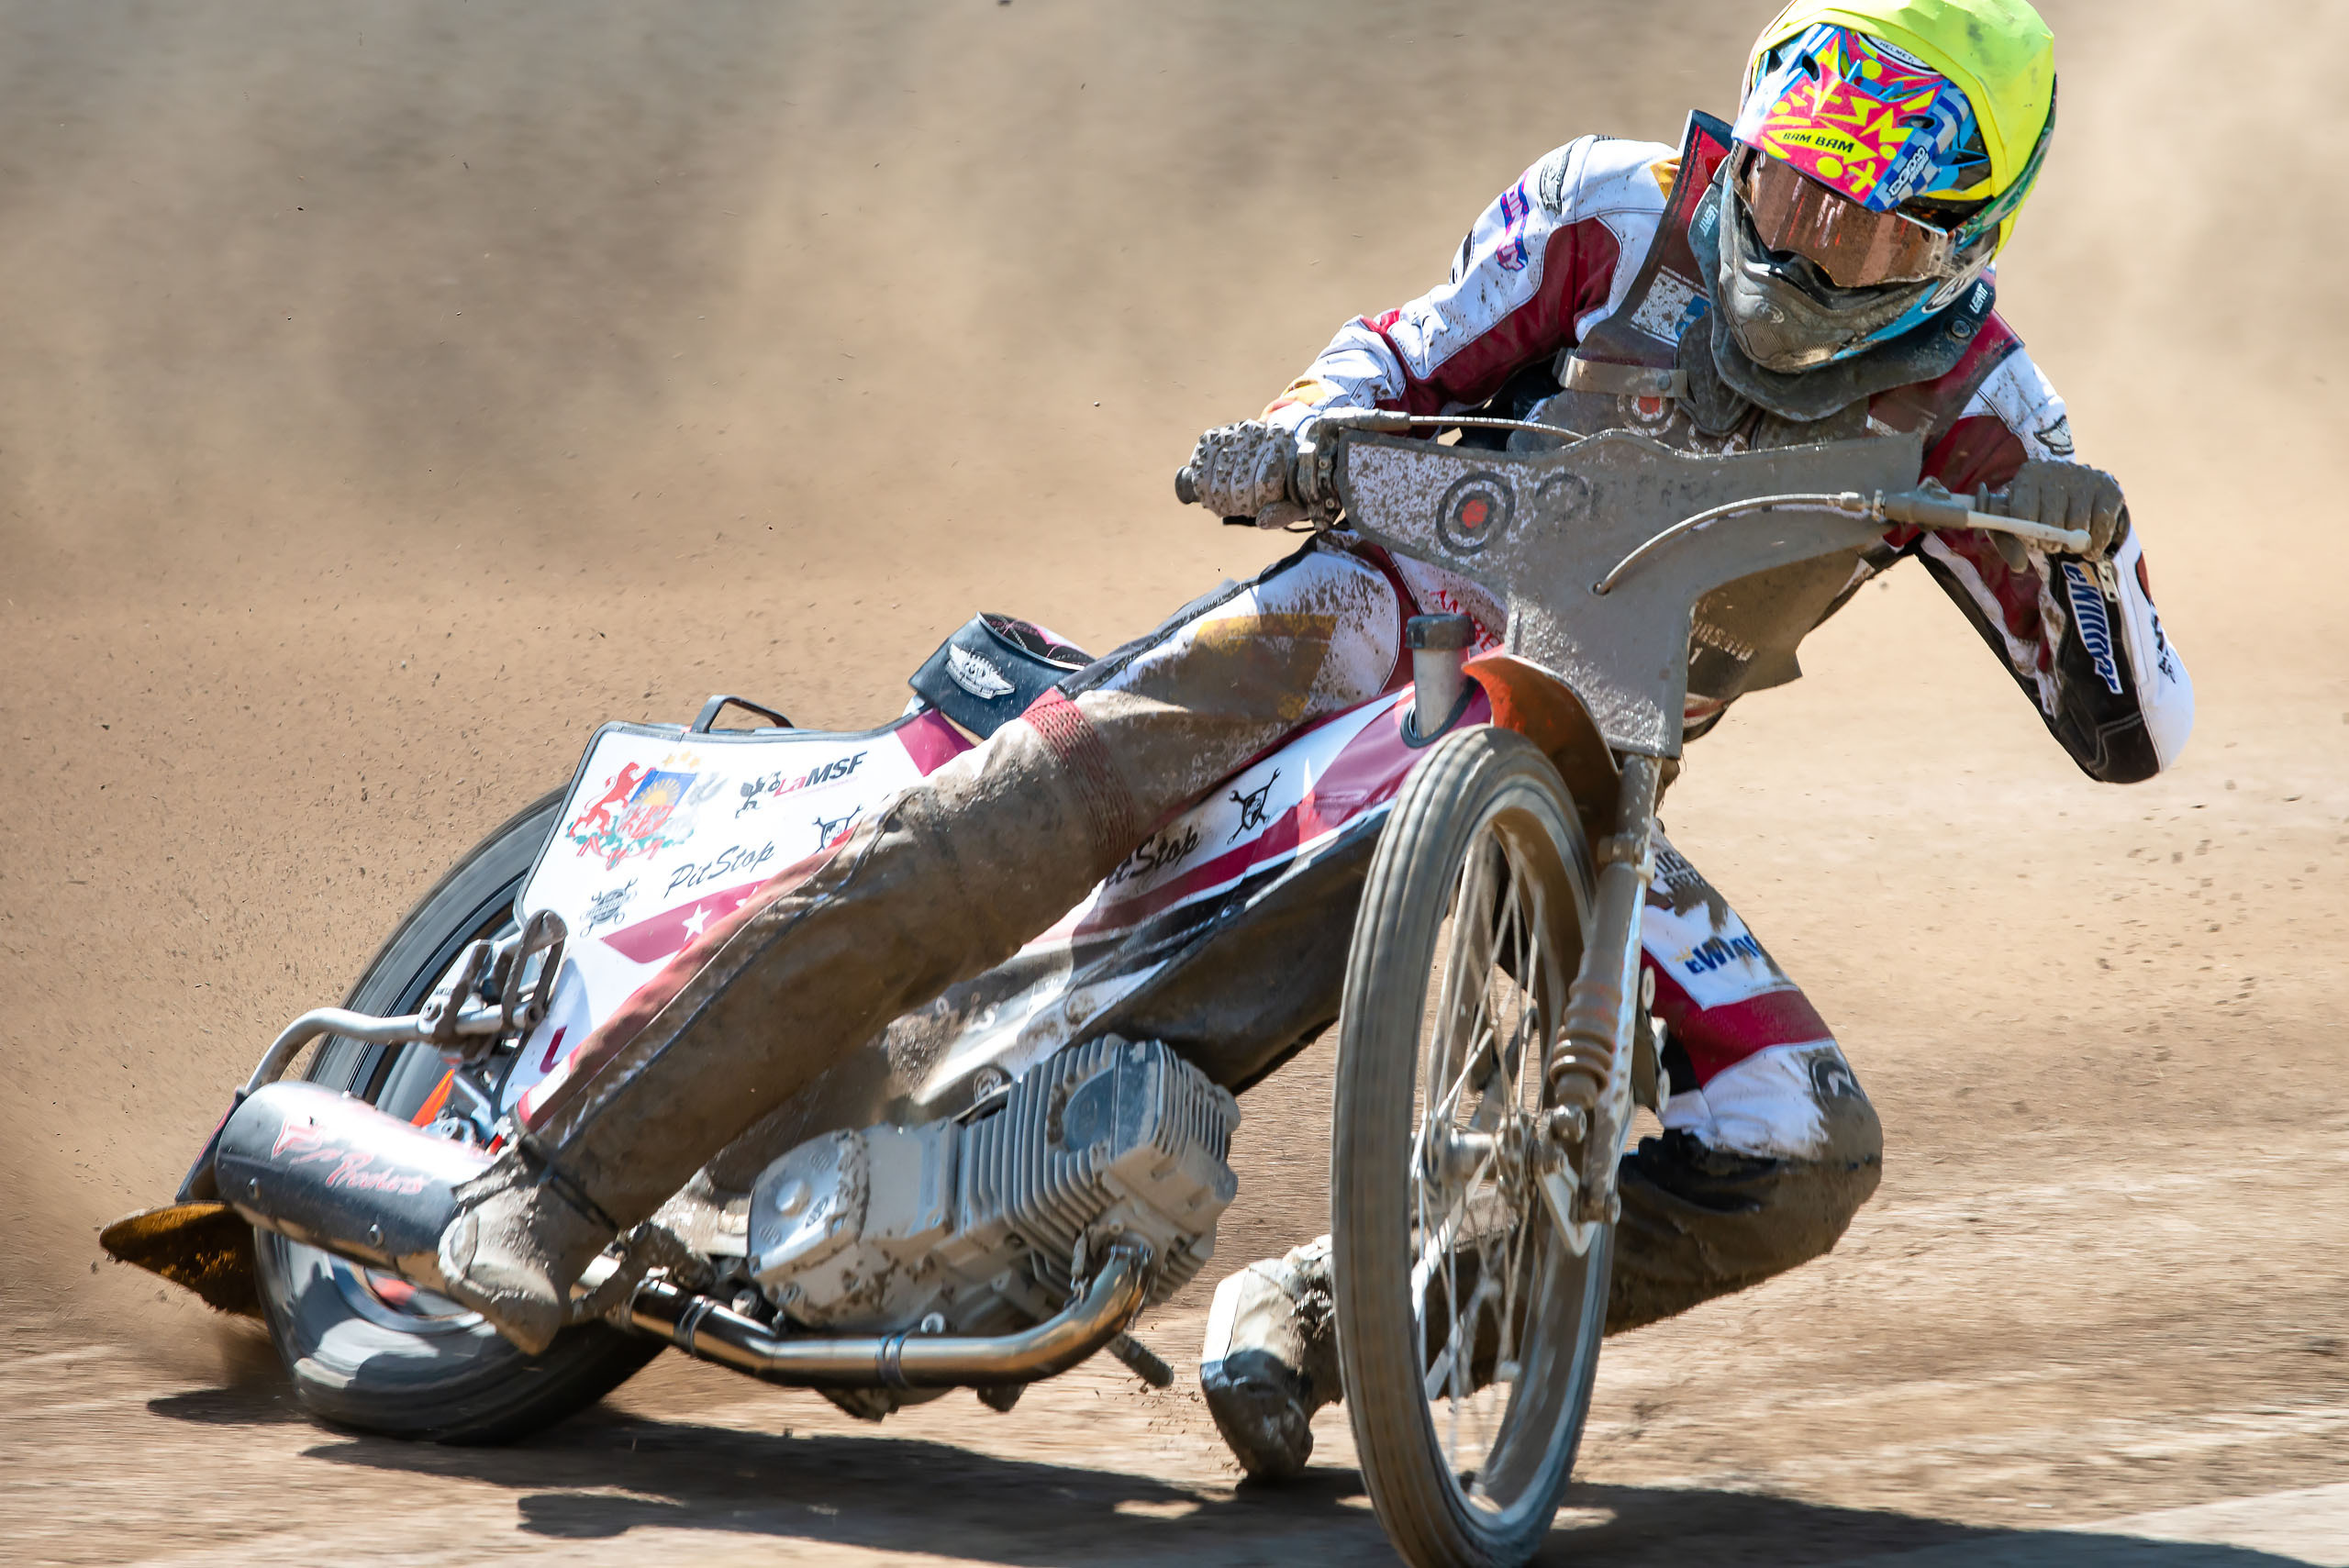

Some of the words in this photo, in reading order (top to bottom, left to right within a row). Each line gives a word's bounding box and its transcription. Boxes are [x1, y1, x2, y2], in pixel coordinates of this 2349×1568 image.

[1783, 132, 1812, 144] BAM
[1815, 136, 1855, 153] BAM
[773, 751, 868, 797] LaMSF
[662, 840, 776, 900] PitStop
